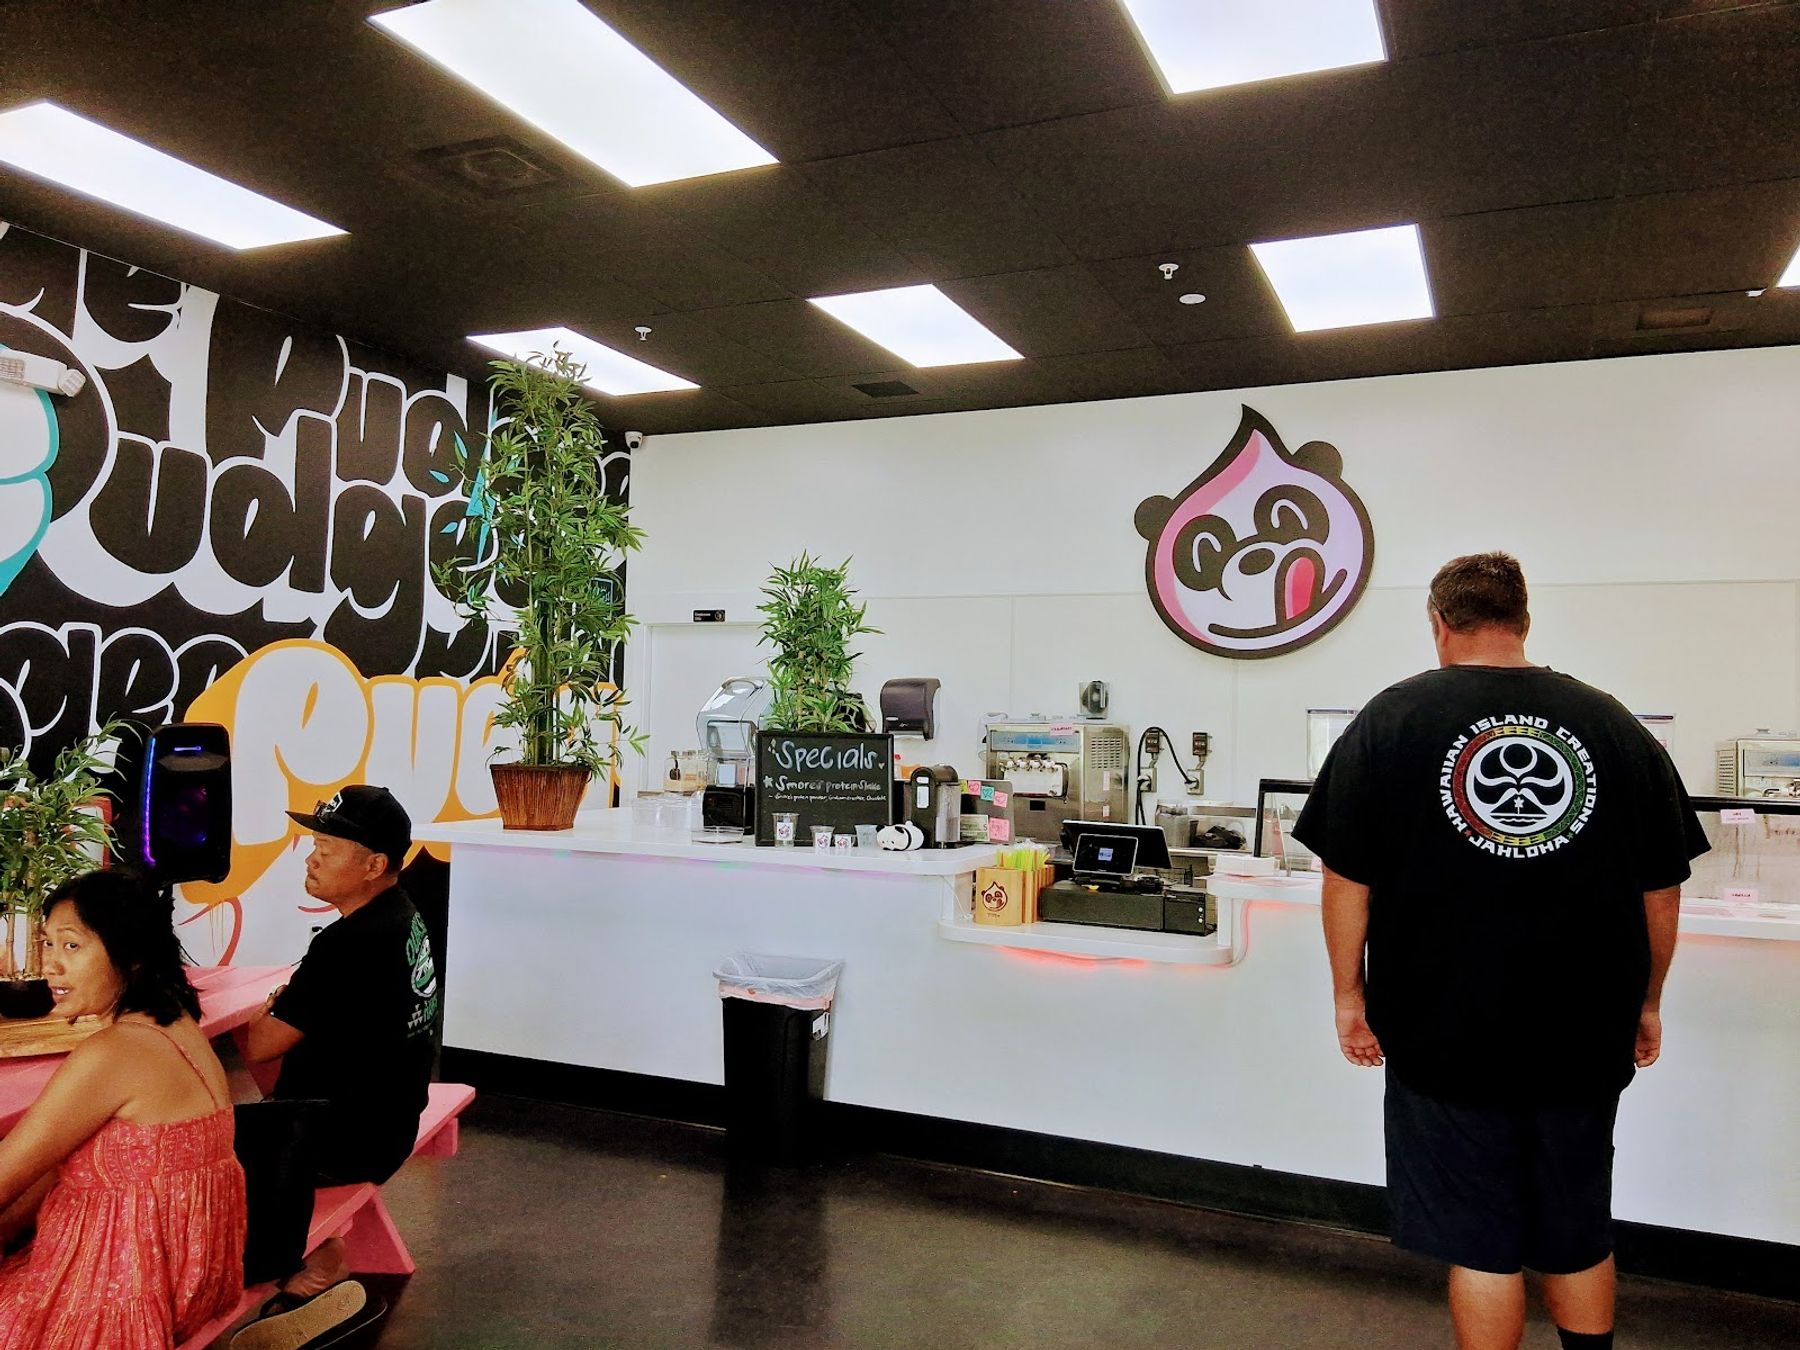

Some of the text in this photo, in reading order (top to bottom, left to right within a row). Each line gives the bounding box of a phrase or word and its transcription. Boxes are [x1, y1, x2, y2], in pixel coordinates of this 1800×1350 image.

[775, 740, 878, 772] Specials
[826, 781, 858, 793] protein
[1439, 714, 1597, 835] HAWAIIAN ISLAND CREATIONS
[1468, 835, 1570, 859] JAHLOHA
